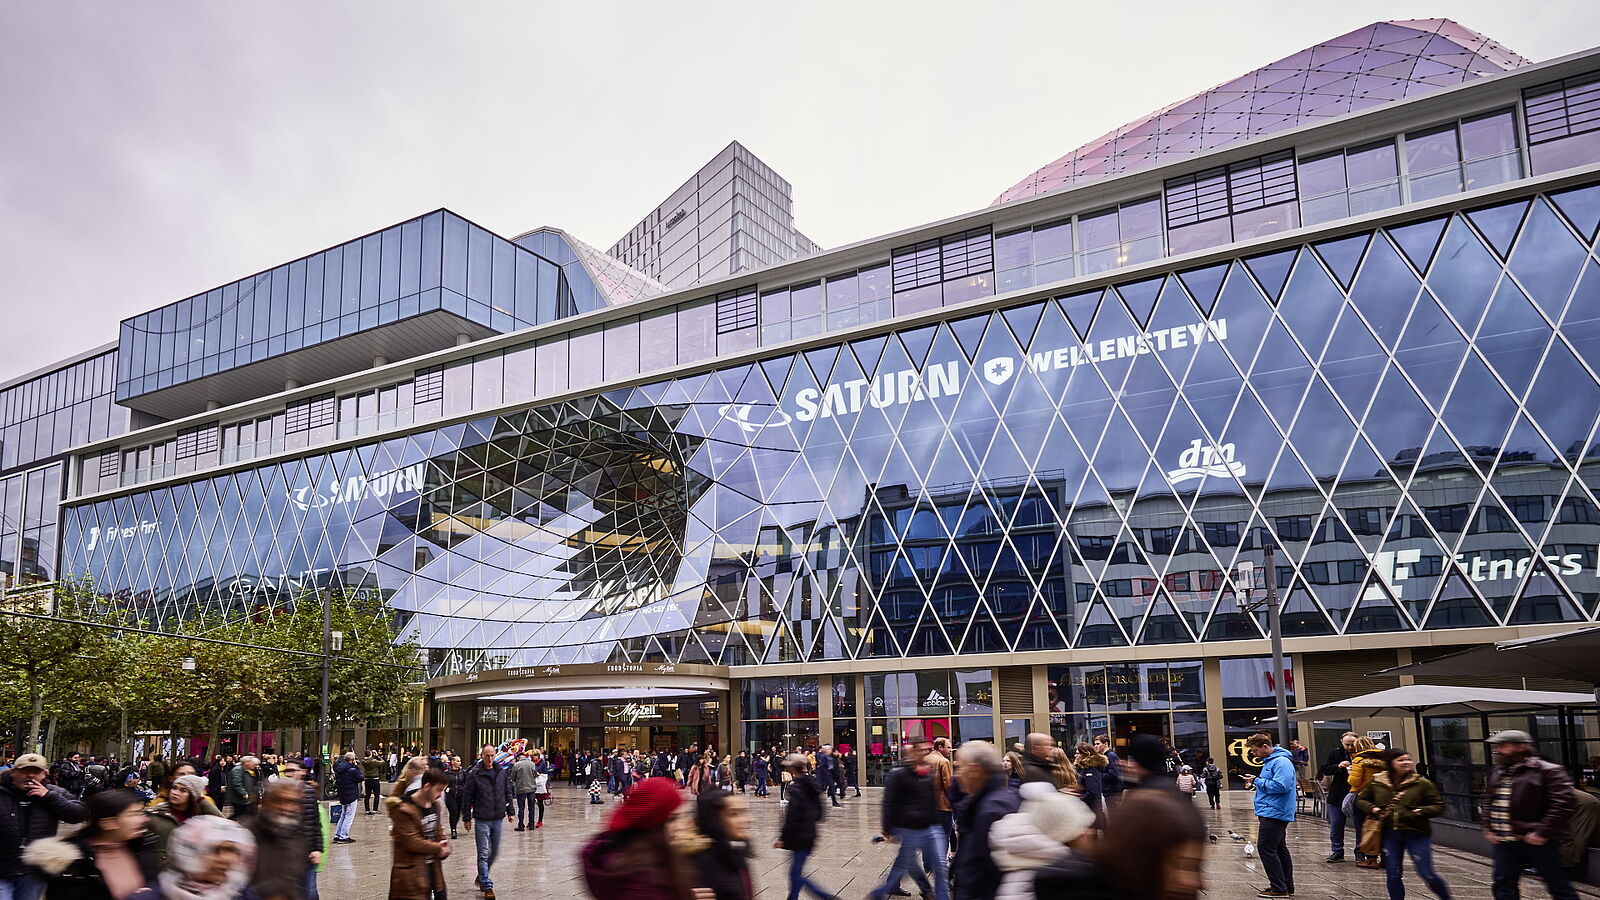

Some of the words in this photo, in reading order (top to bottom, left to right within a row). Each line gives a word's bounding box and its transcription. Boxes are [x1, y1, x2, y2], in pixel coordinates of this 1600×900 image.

[1026, 318, 1228, 374] WELLENSTEYN
[795, 360, 960, 422] SATURN
[1178, 438, 1235, 469] dm
[330, 463, 425, 504] SATURN
[607, 703, 656, 726] MyZeil
